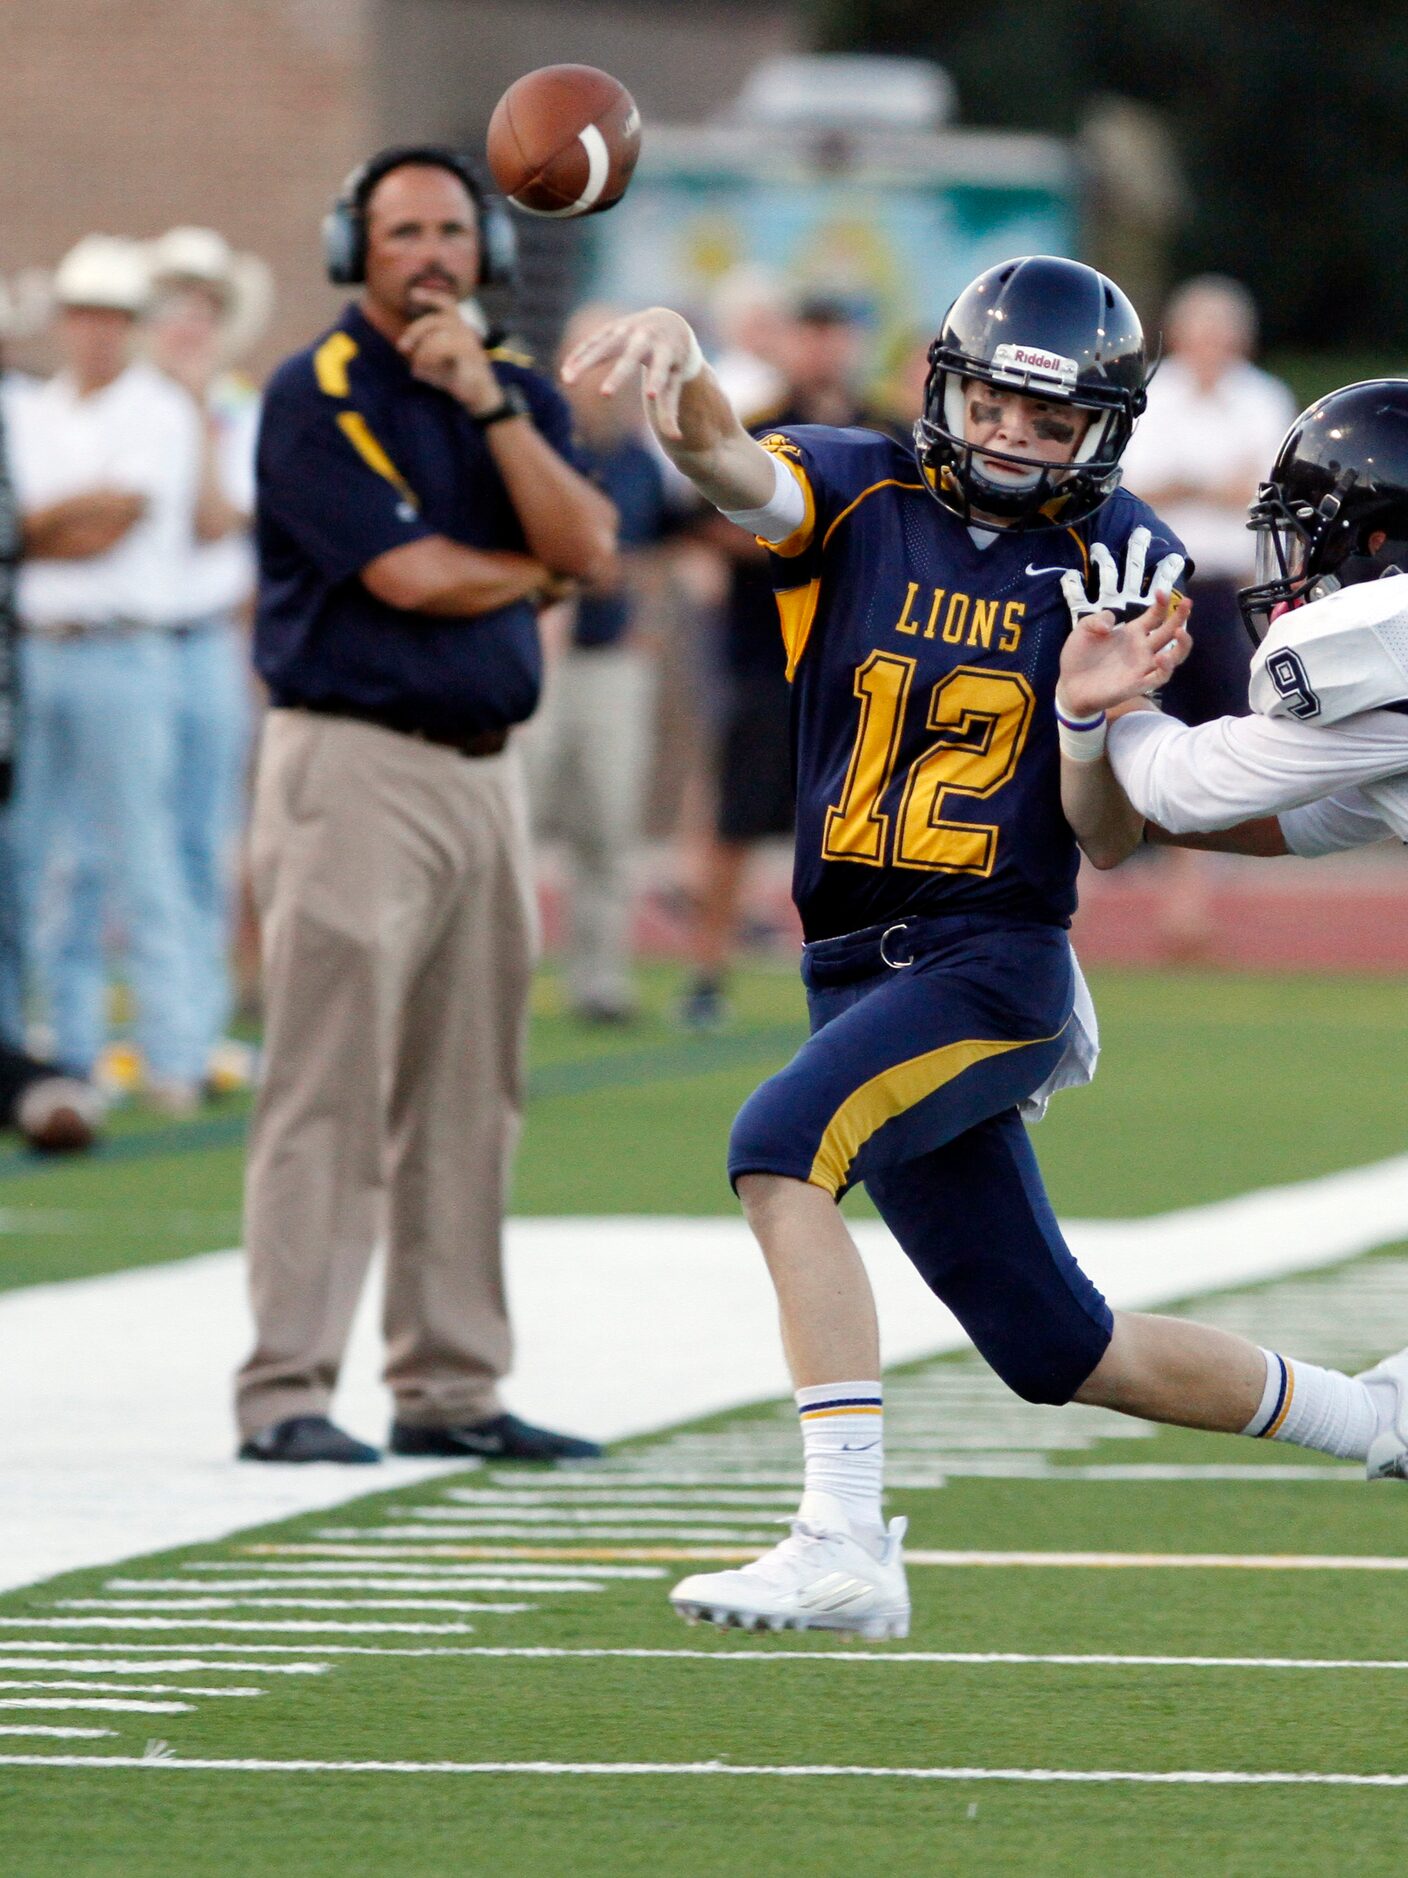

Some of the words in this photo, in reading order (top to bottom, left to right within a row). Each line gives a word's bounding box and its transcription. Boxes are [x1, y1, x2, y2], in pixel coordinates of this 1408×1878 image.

[1014, 350, 1060, 371] Riddell
[896, 582, 1025, 652] LIONS
[1265, 645, 1321, 720] 9
[821, 648, 1037, 877] 12
